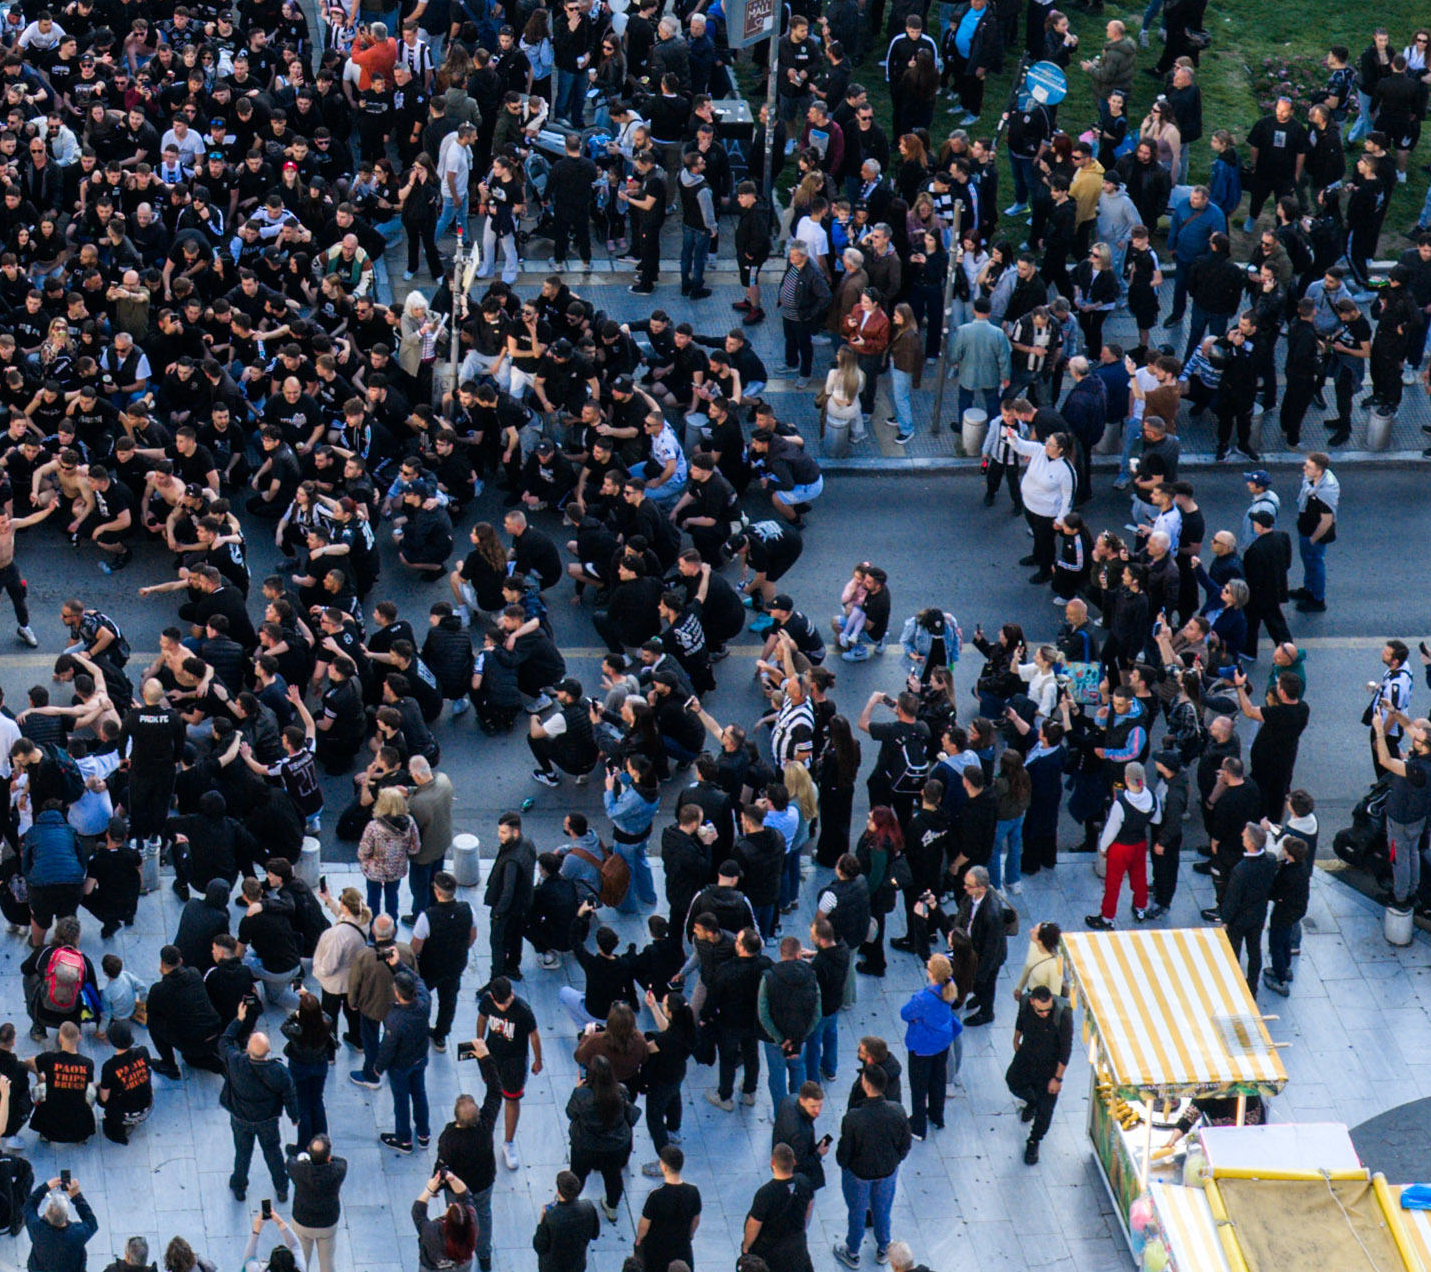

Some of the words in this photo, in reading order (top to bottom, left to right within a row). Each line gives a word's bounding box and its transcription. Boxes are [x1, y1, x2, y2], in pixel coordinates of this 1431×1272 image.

[747, 4, 770, 20] MALL
[140, 715, 159, 723] PAOK
[160, 715, 169, 723] FC
[54, 1063, 87, 1074] PAOK
[55, 1073, 86, 1082] TRIPS
[54, 1081, 85, 1090] DRUGS
